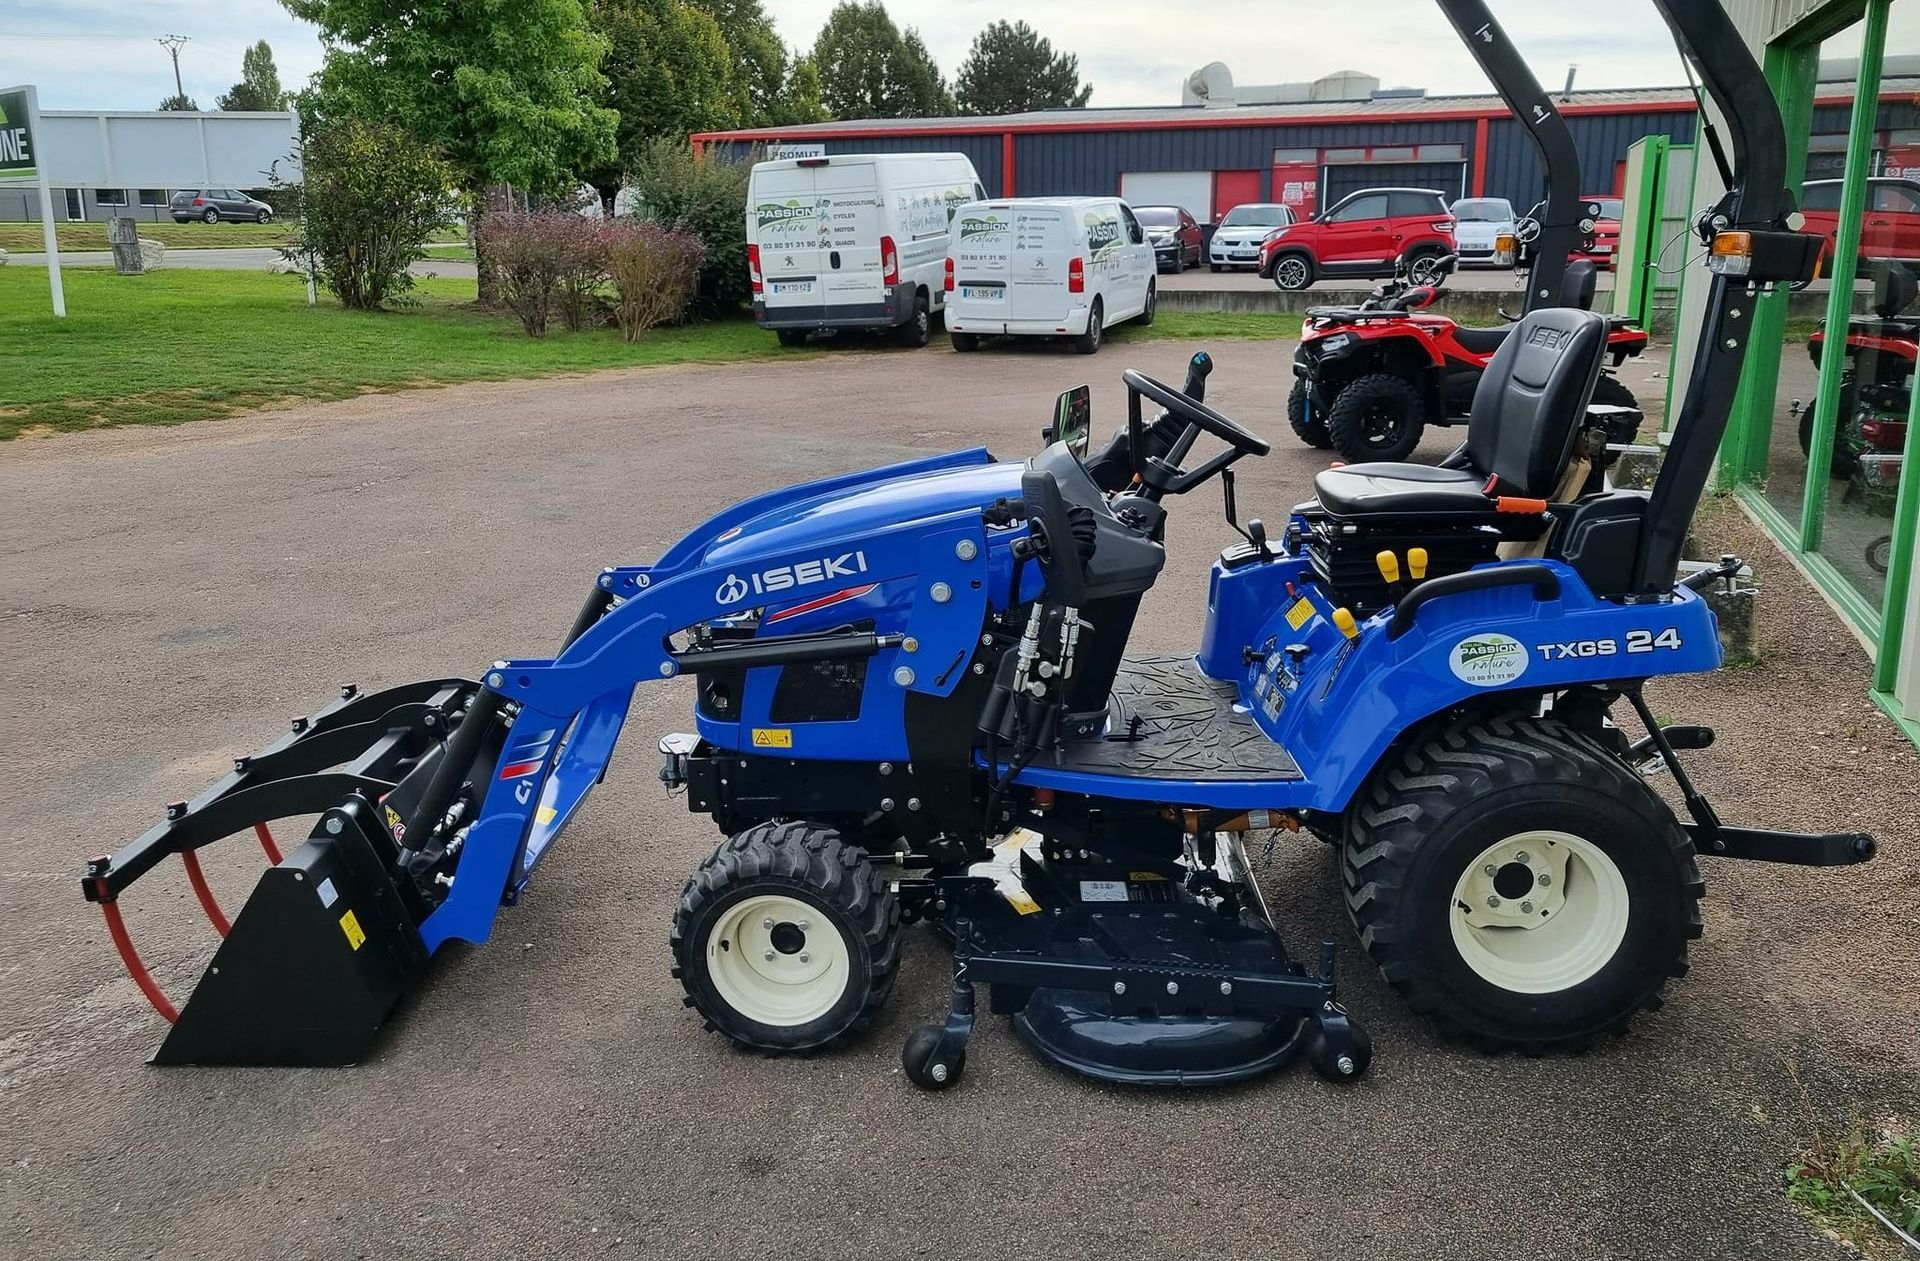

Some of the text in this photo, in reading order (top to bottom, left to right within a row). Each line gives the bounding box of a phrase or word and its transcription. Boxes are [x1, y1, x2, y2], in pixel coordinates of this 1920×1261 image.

[0, 127, 30, 162] NE
[758, 207, 814, 218] PASSION
[961, 222, 1009, 231] PASSION
[1088, 222, 1119, 242] PASSION
[751, 550, 868, 594] ISEKI
[1460, 644, 1518, 655] PASSION
[1537, 628, 1682, 660] TXGS 24
